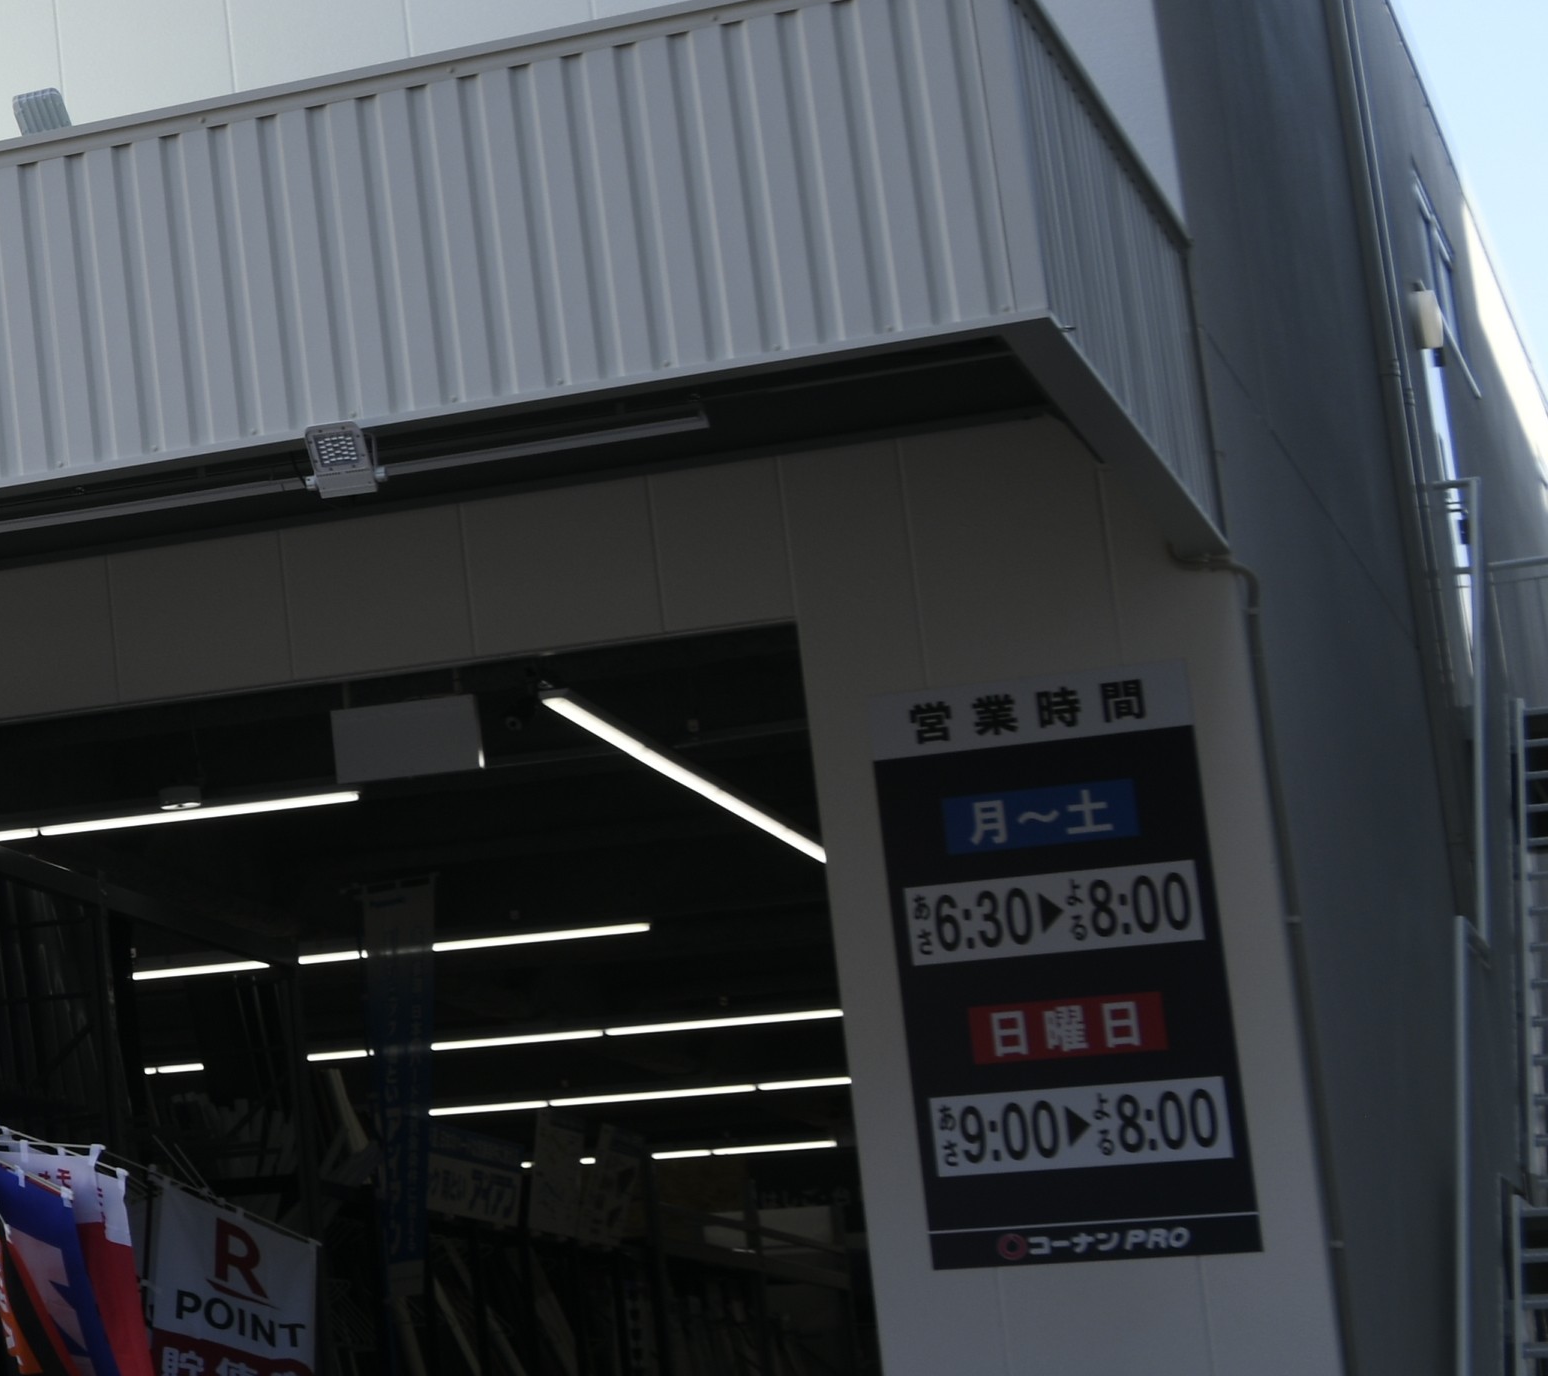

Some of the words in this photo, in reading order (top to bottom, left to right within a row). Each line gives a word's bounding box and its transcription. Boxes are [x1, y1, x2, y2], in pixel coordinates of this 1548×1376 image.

[910, 679, 1147, 745] 営業時間
[912, 893, 935, 956] あさ
[935, 886, 1033, 952] 6:30
[1065, 877, 1088, 942] よる
[1088, 870, 1192, 937] 8:00
[990, 1000, 1142, 1056] 日曜日
[937, 1104, 959, 1167] あさ
[960, 1099, 1061, 1164] 9:00
[1092, 1093, 1115, 1156] よる
[1116, 1087, 1219, 1154] 8:00
[175, 1289, 307, 1349] POINT
